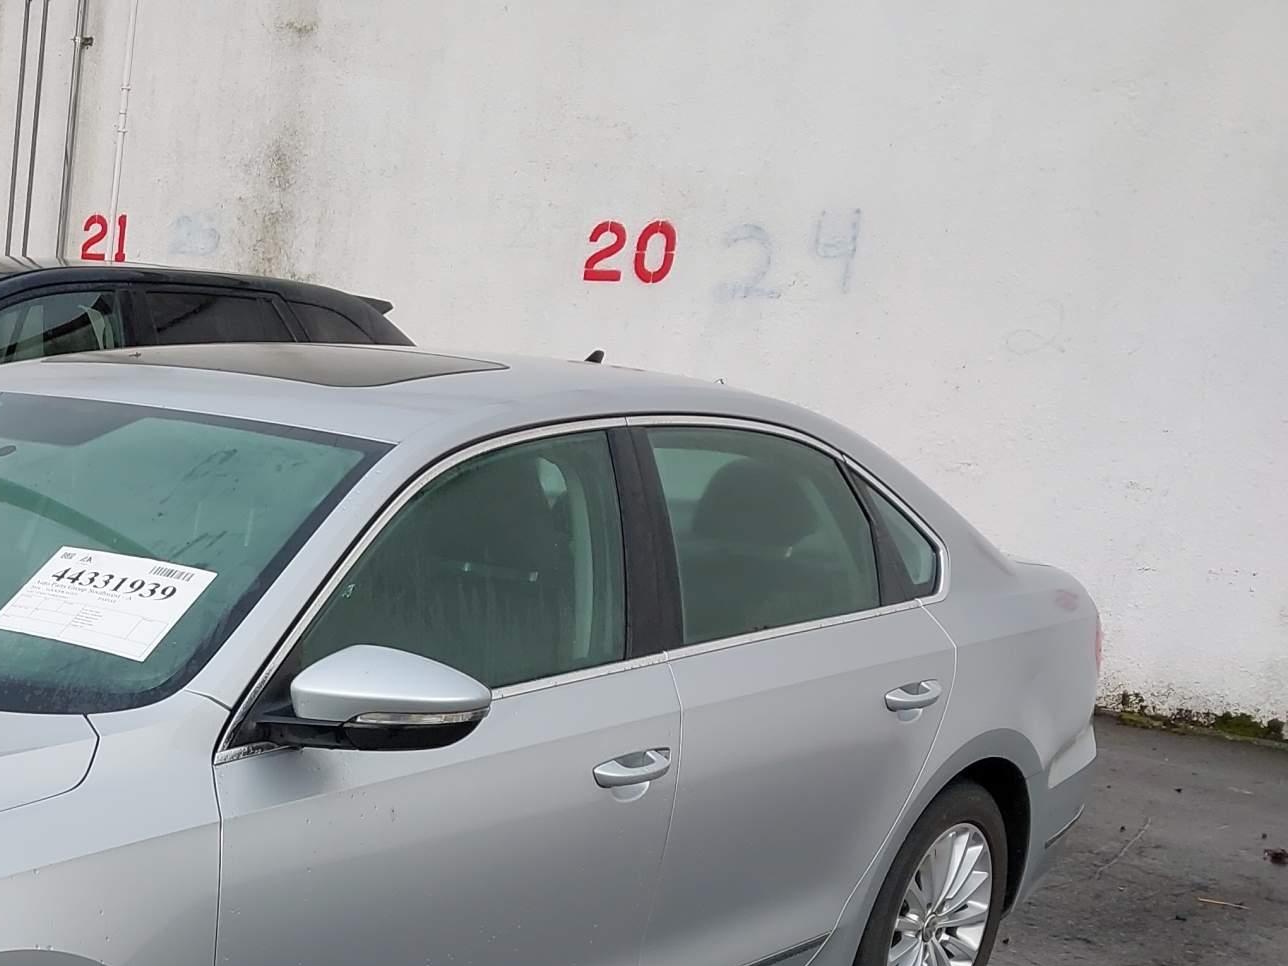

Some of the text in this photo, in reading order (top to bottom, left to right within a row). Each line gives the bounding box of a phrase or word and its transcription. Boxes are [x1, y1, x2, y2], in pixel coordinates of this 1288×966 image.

[81, 214, 128, 262] 21
[583, 219, 678, 284] 20
[51, 567, 177, 601] 44331939
